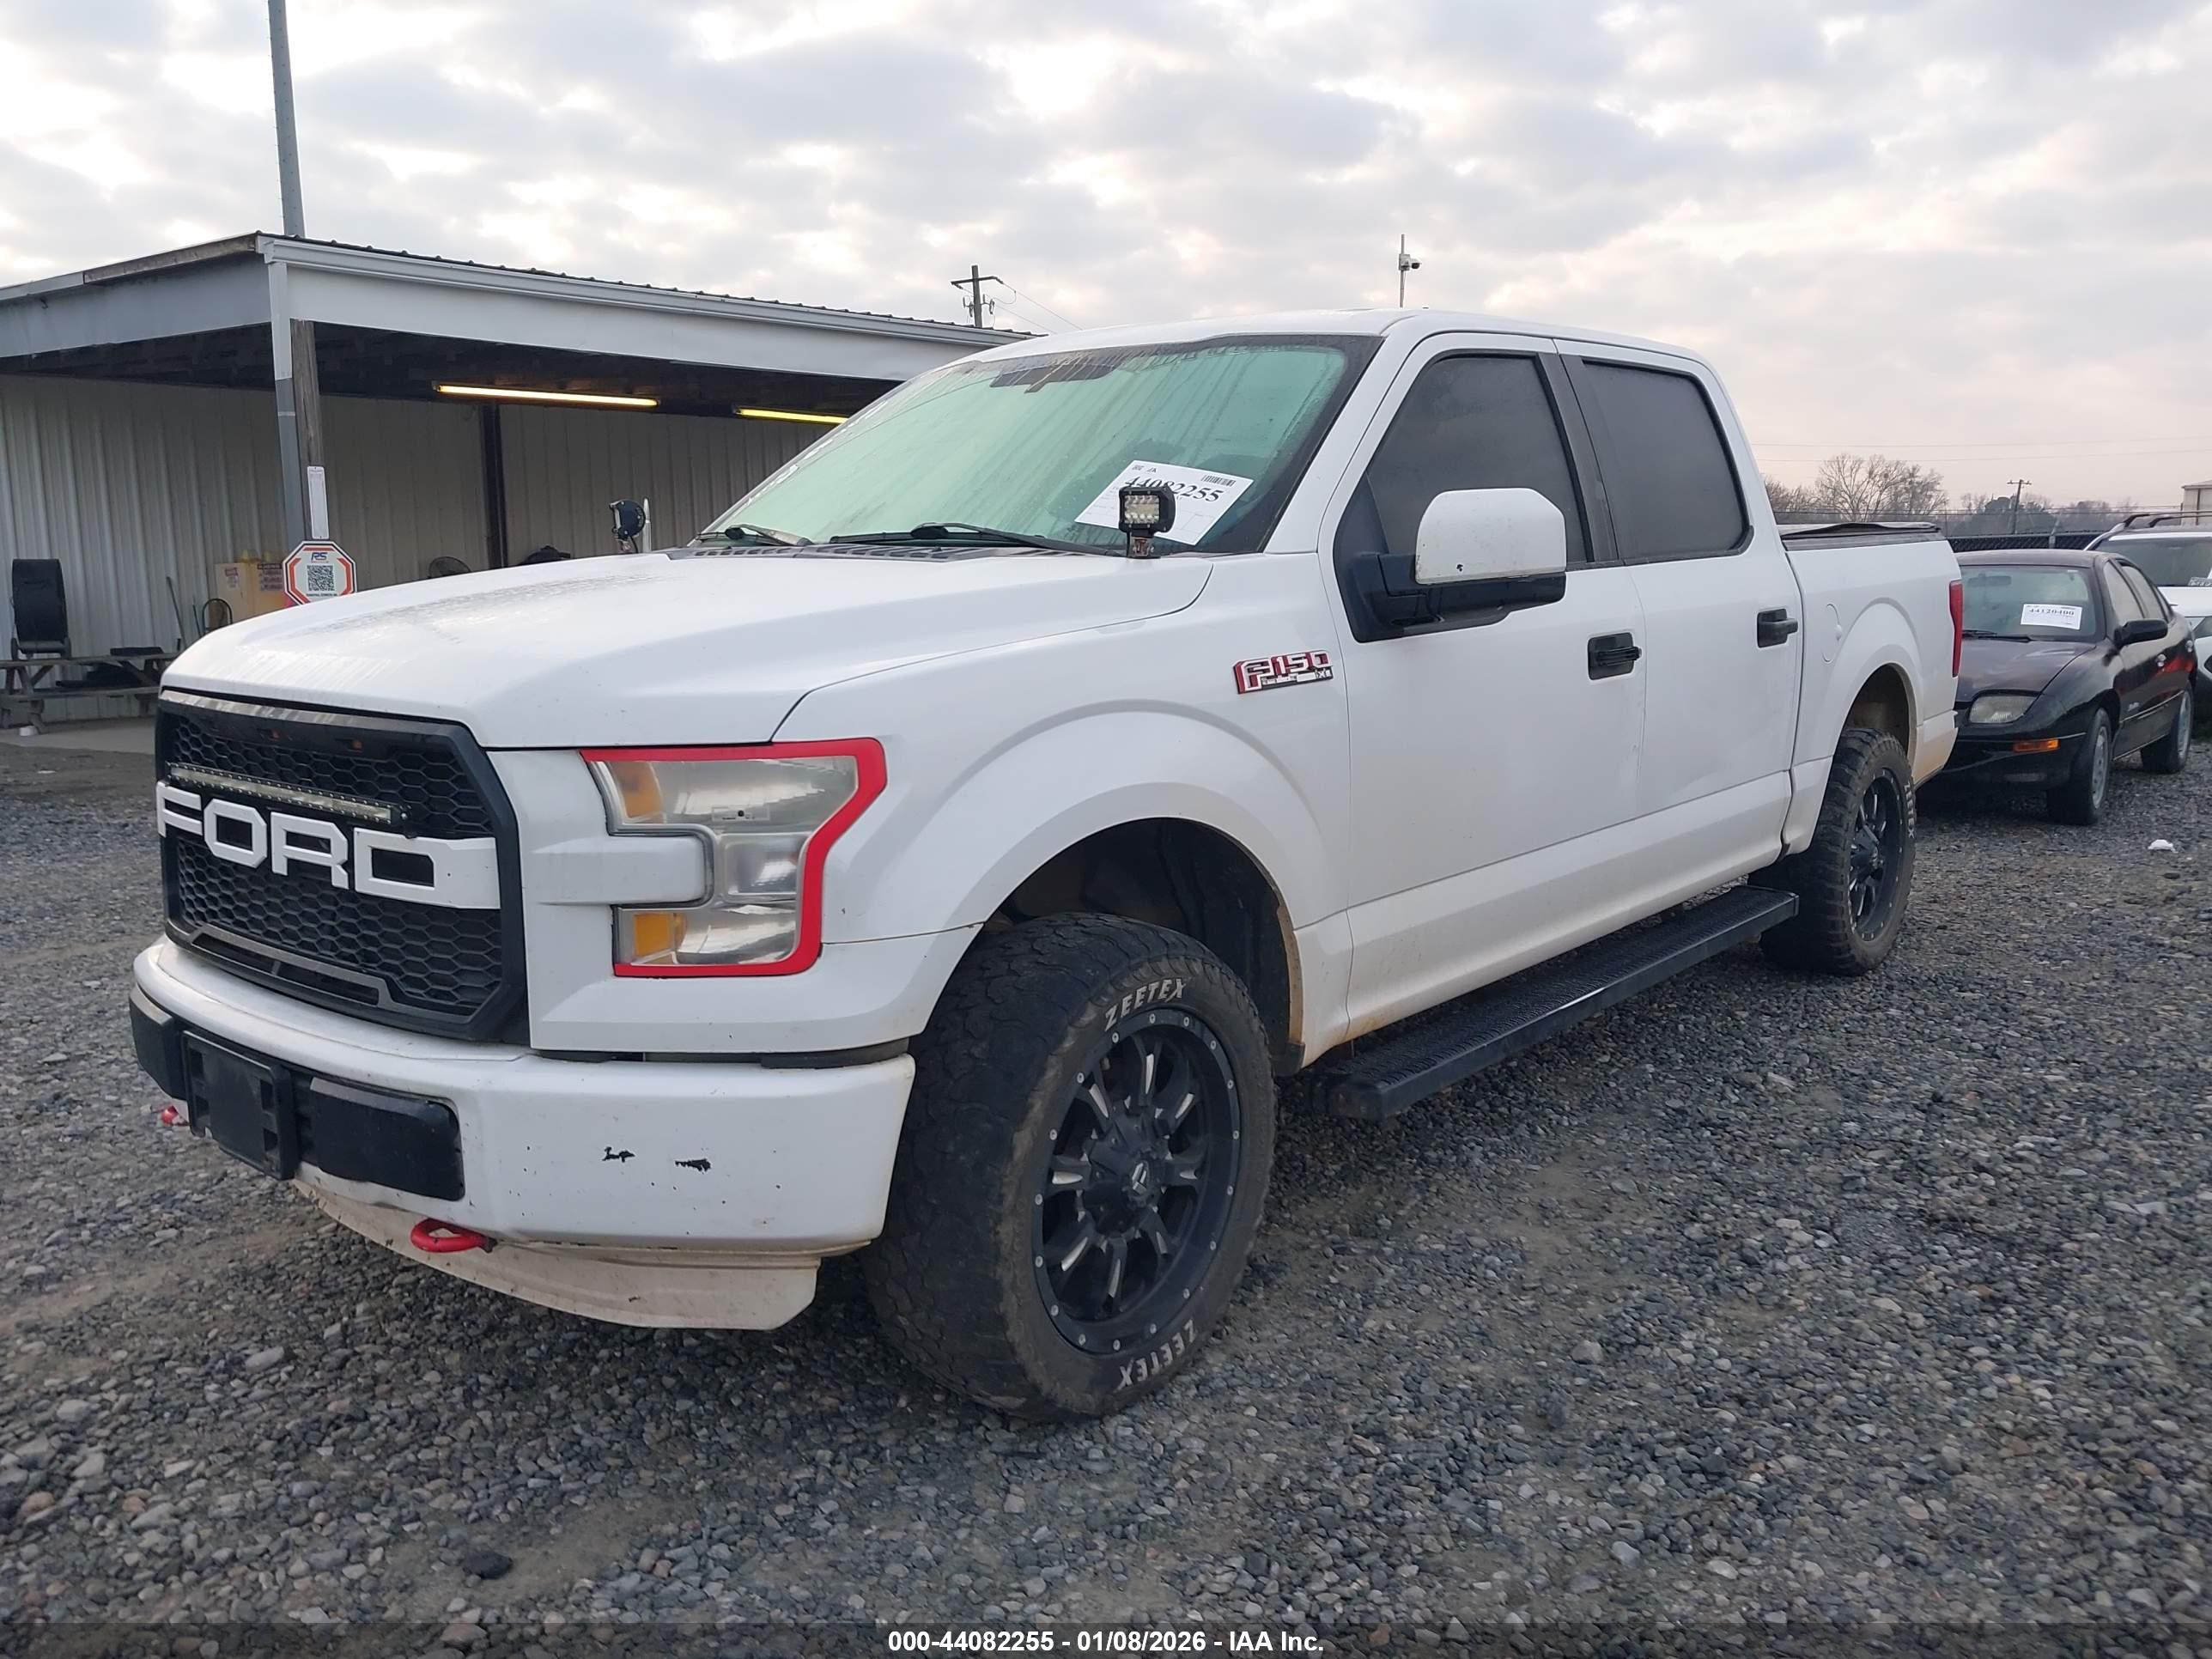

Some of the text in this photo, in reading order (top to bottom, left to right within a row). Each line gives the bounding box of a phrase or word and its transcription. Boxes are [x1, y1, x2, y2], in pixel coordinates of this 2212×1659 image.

[156, 781, 501, 909] FORD
[1104, 978, 1187, 1032] ZEETEX
[1116, 1319, 1195, 1391] ZEETEX
